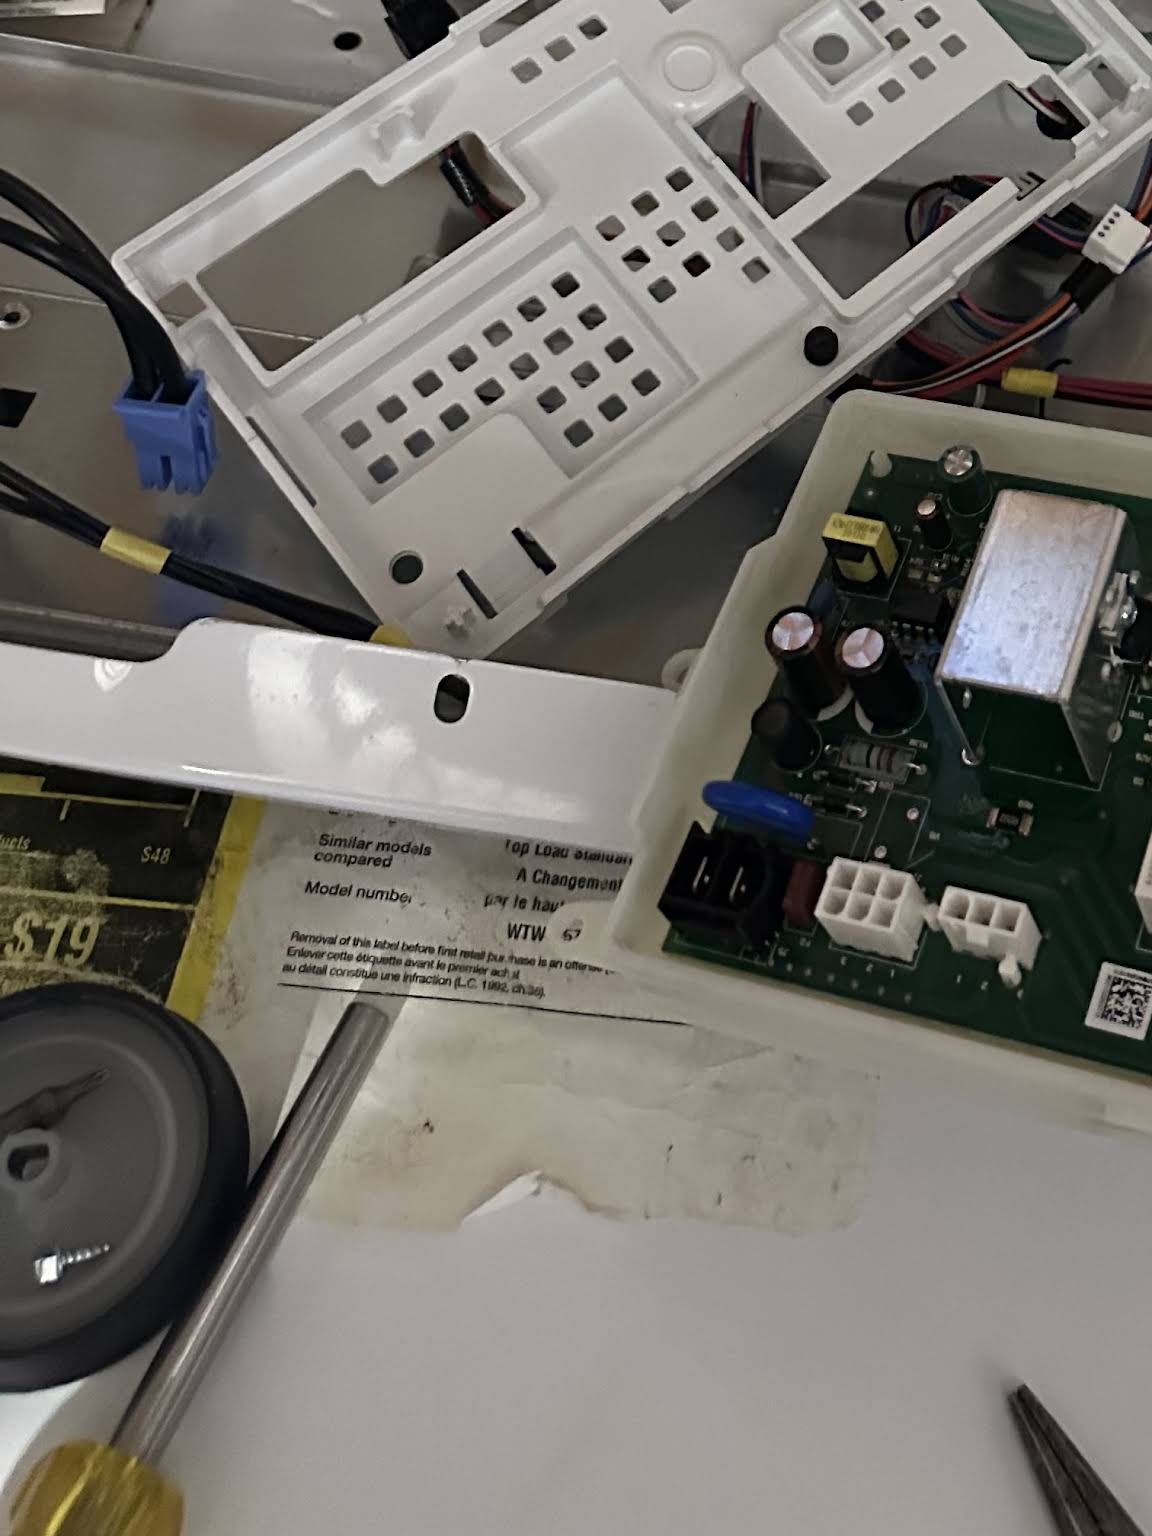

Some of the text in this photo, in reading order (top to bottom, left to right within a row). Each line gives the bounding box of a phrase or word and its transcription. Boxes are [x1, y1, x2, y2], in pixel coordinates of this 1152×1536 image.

[319, 834, 432, 857] Similar models
[314, 851, 394, 869] compared
[516, 867, 527, 882] A
[305, 880, 353, 898] Model
[513, 894, 528, 909] le
[507, 922, 546, 943] WTW
[290, 931, 338, 945] Removal
[339, 936, 351, 946] of
[353, 938, 371, 948] this
[374, 940, 399, 951] label
[401, 942, 436, 954] before
[437, 946, 457, 956] first
[460, 948, 486, 961] retail
[538, 957, 547, 967] is
[549, 959, 563, 969] an
[287, 946, 326, 959] Enlever
[327, 950, 353, 962] cette
[356, 953, 403, 969] étiquette
[404, 957, 435, 969] avant
[436, 961, 446, 970] le
[448, 962, 489, 976] premier
[282, 963, 296, 973] au
[299, 963, 328, 975] détail
[329, 966, 378, 980] constitue
[381, 971, 401, 982] une
[403, 972, 452, 986] infraction
